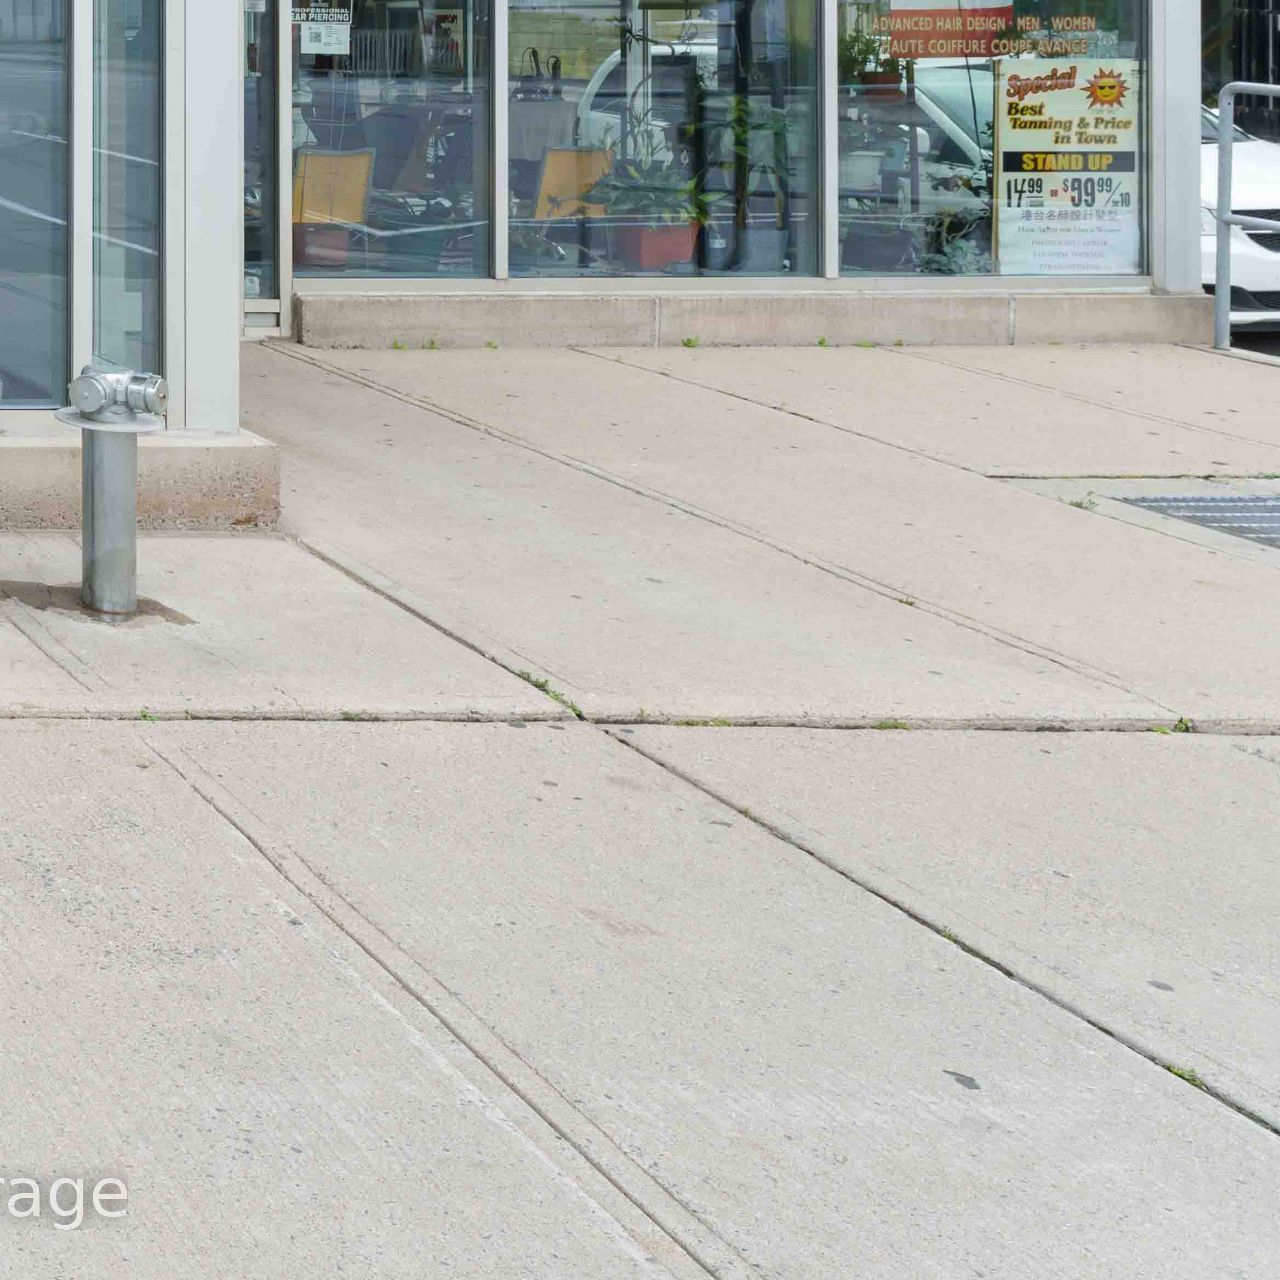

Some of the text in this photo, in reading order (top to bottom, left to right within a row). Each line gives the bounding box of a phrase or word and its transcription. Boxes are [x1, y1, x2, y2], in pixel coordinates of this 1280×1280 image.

[290, 13, 350, 22] EAR PIERCING
[872, 16, 1096, 32] ADVANCED HAIR DESIGN MEN WOMEN
[882, 39, 1090, 55] HAUTE COIFFURE COUPE AVANCE
[1006, 66, 1077, 101] Special
[1007, 102, 1045, 116] Best
[1010, 117, 1133, 132] Tanning & Price
[1053, 131, 1118, 144] in Town
[1021, 153, 1114, 170] STAND UP
